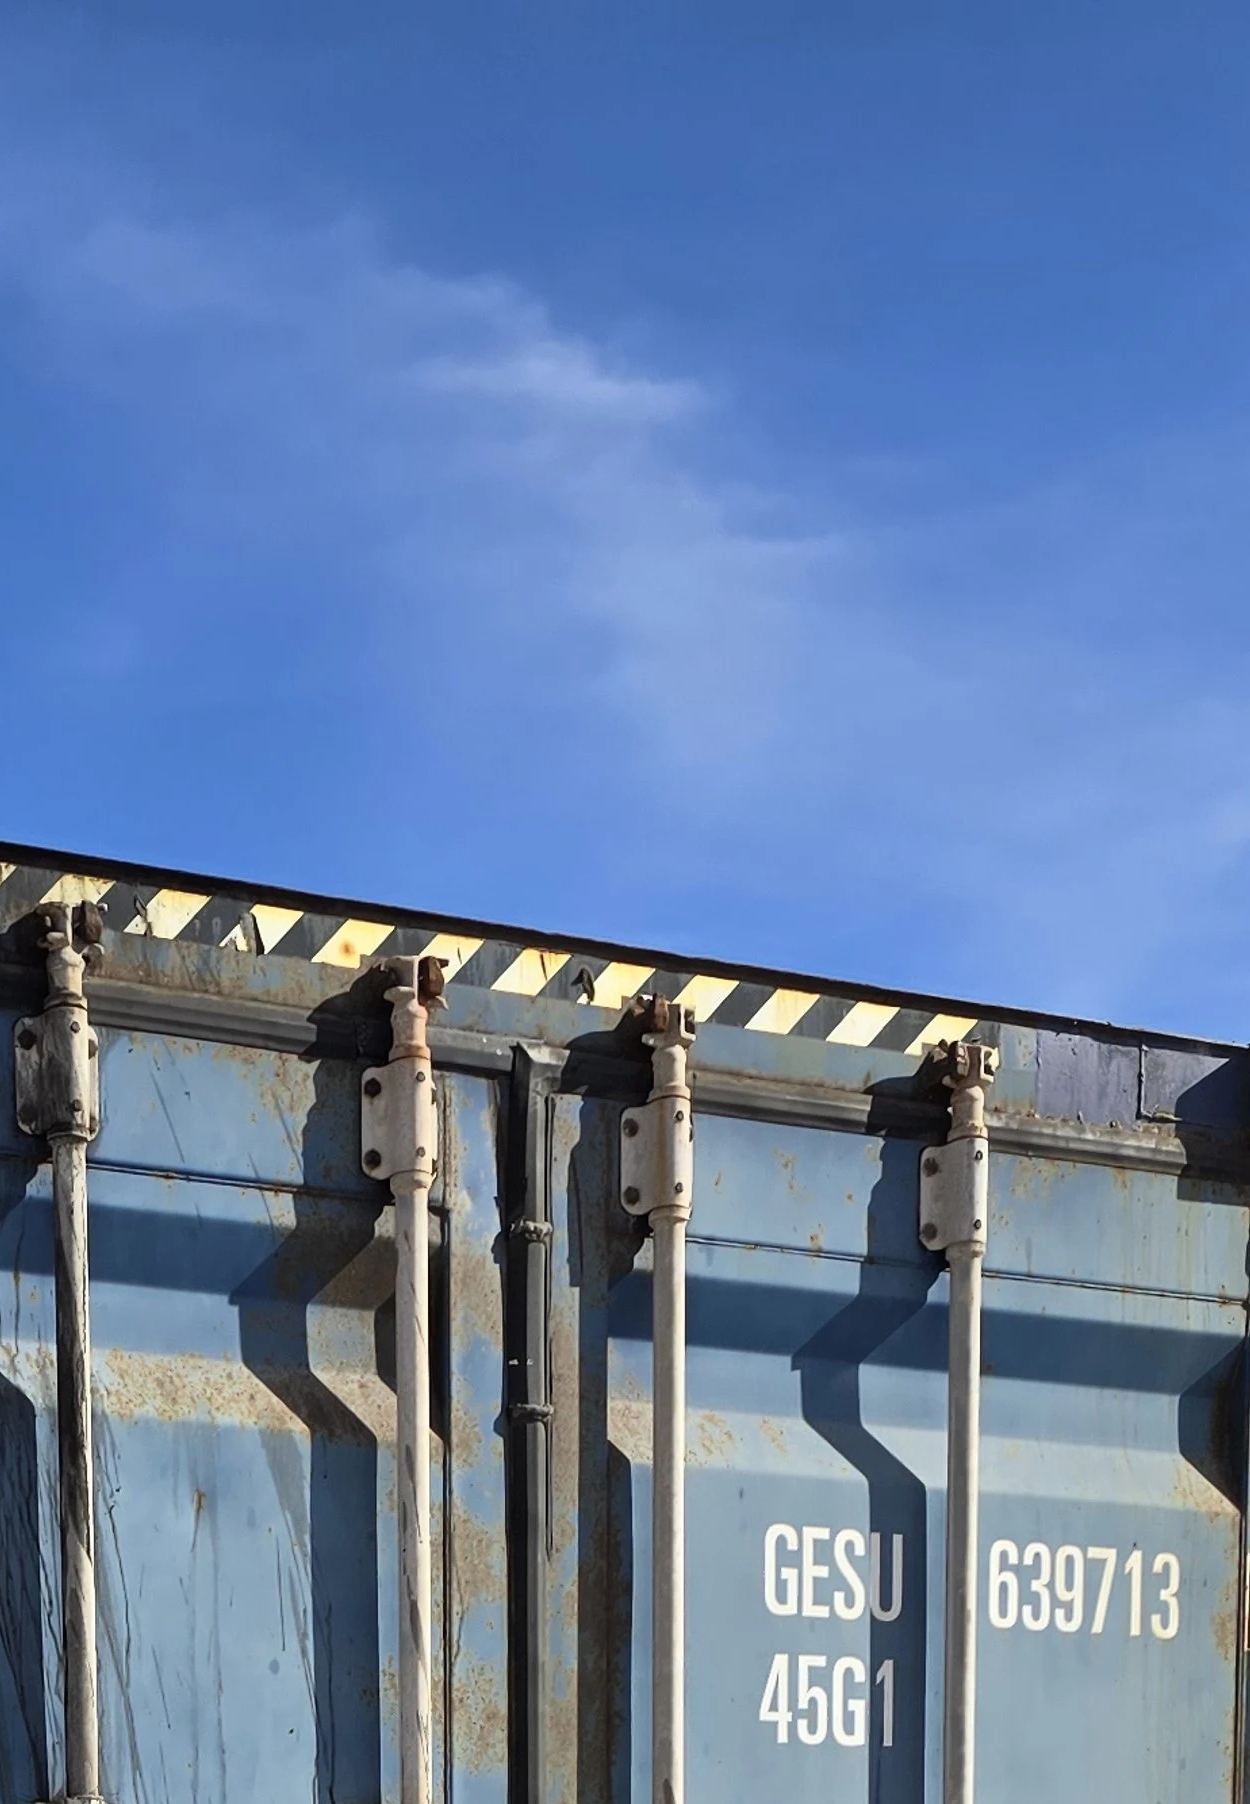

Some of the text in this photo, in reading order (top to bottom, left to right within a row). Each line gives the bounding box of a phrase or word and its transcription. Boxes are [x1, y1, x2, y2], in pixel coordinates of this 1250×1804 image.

[763, 1523, 1181, 1640] GESU 639713
[758, 1653, 894, 1746] 45G1
